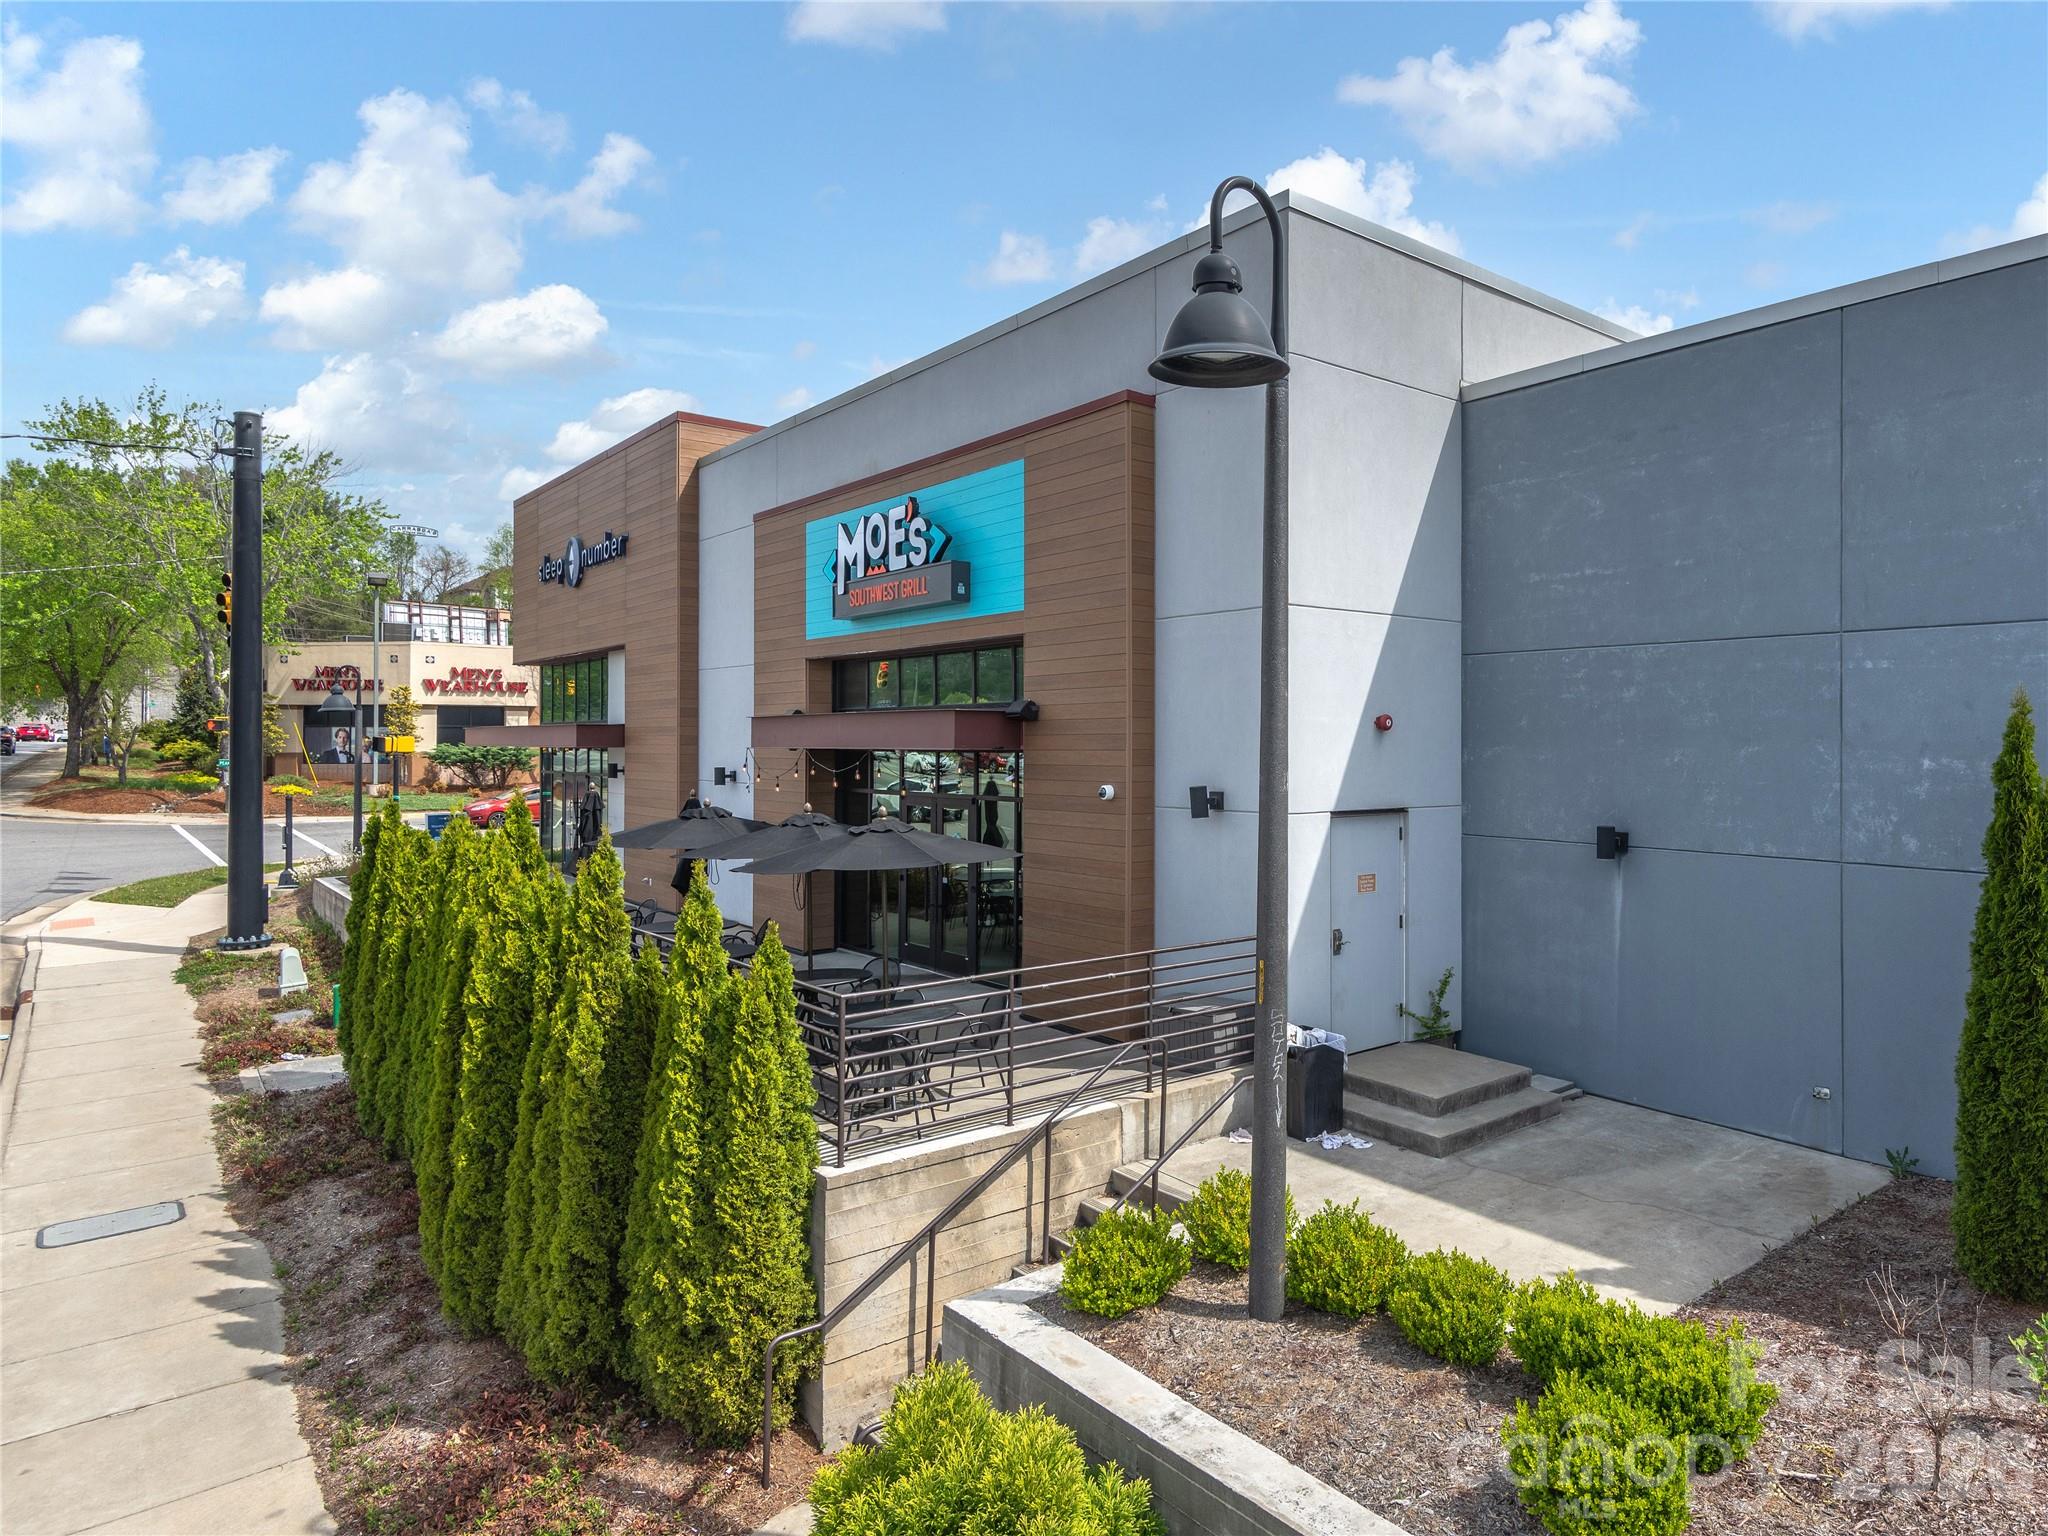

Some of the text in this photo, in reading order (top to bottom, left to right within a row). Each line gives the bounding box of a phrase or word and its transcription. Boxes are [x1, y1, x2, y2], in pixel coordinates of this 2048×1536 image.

[538, 530, 629, 584] sleep number
[836, 496, 930, 596] MOE'S
[849, 580, 899, 608] SOUTHWEST
[901, 575, 928, 599] GRILL
[421, 678, 529, 696] WEARHOUSE
[449, 666, 503, 681] MEN'S
